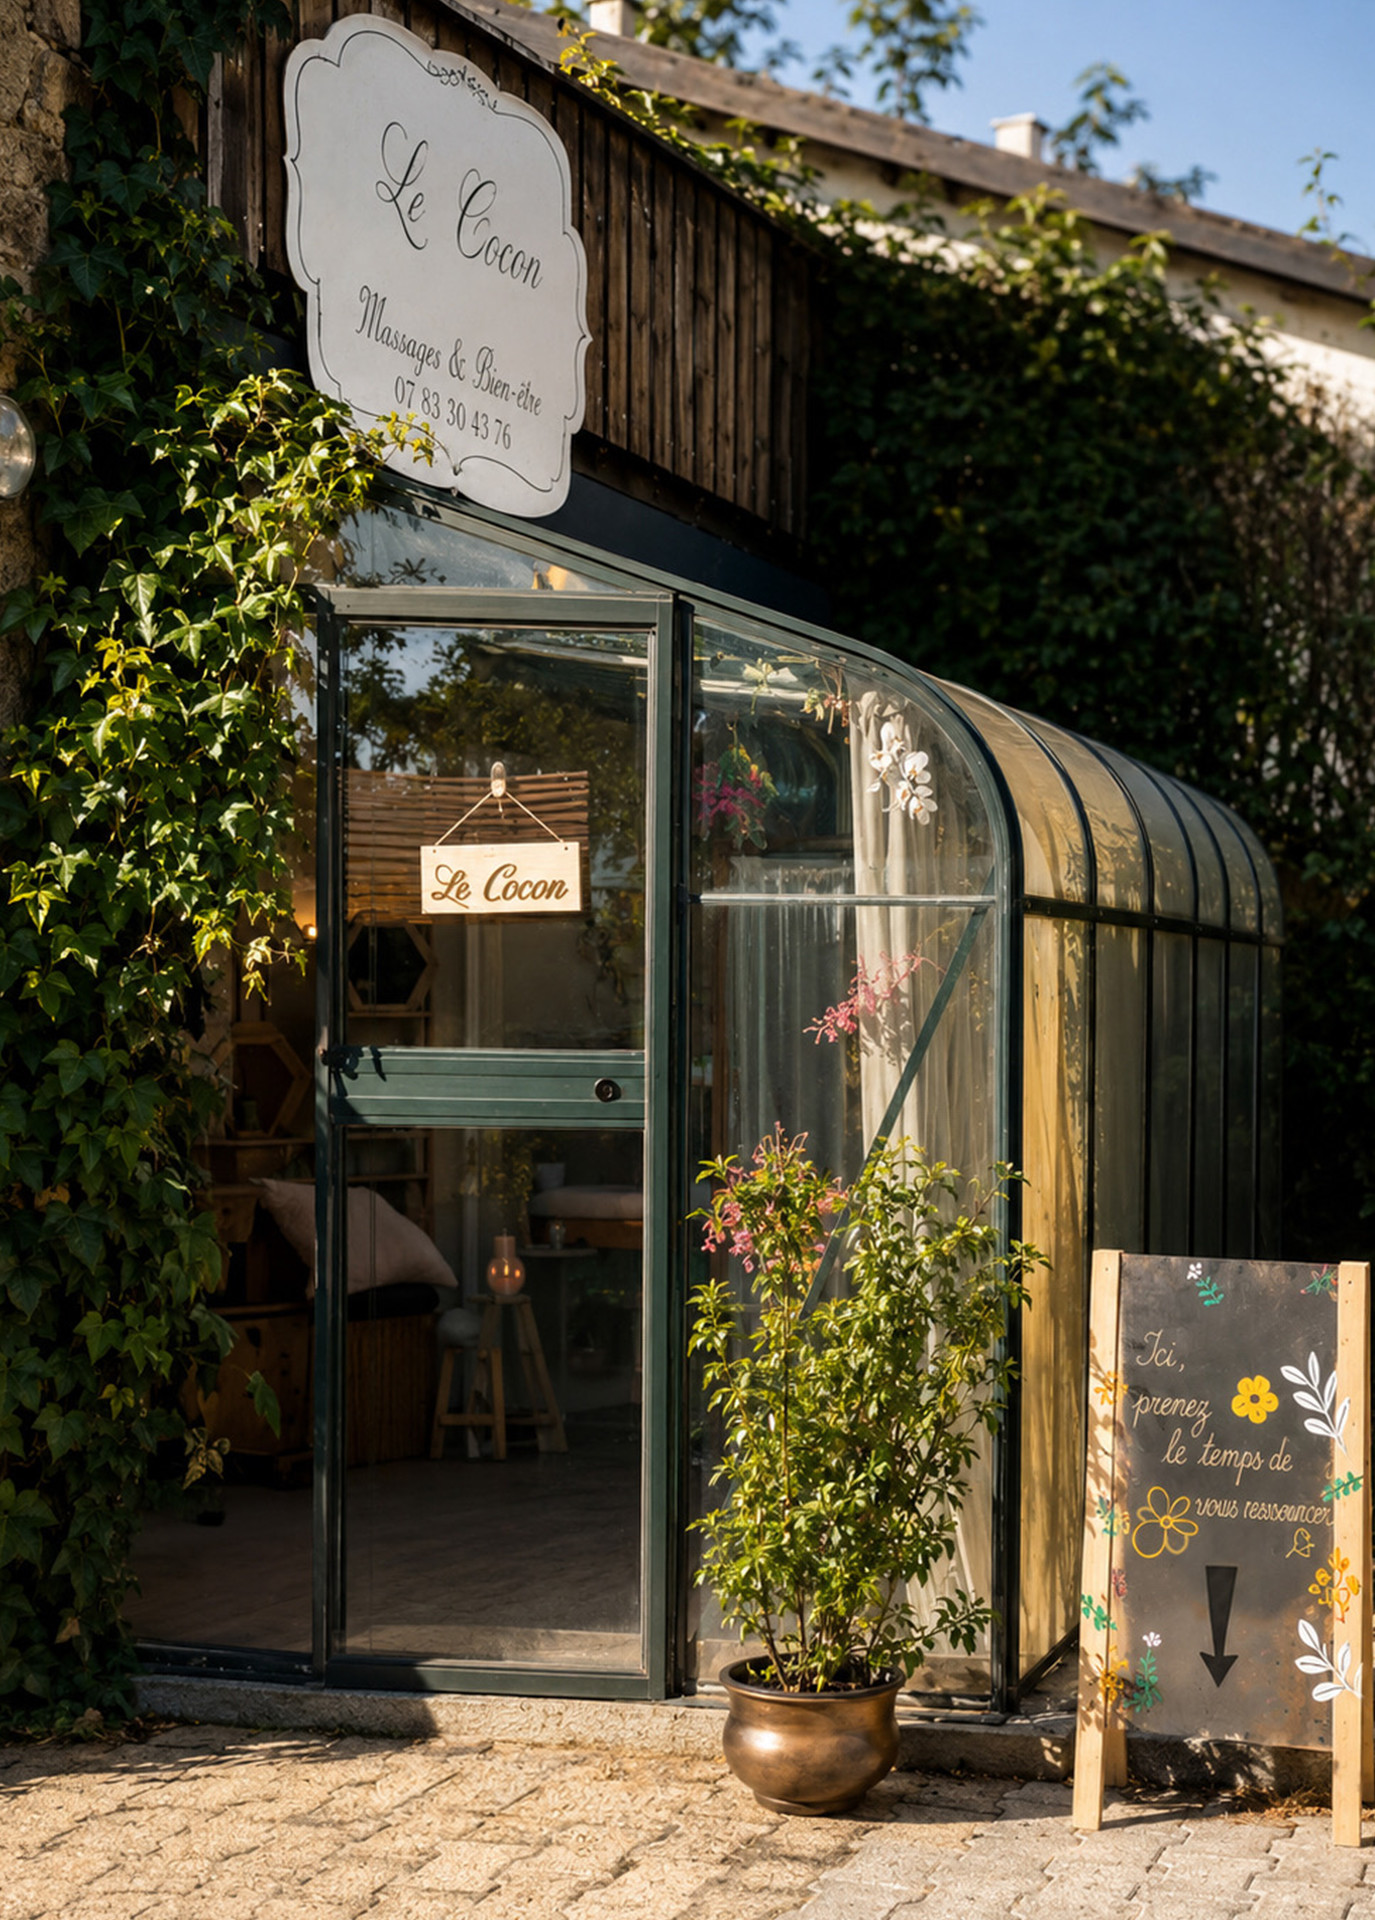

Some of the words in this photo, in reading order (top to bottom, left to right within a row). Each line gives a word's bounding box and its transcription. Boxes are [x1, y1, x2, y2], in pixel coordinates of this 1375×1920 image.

[375, 121, 428, 250] Le
[457, 168, 543, 289] Cocon
[355, 285, 442, 377] Massages
[448, 338, 466, 381] &
[473, 346, 542, 416] Bien-être
[394, 376, 415, 409] 07
[421, 387, 440, 420] 83
[446, 398, 466, 431] 30
[471, 410, 489, 440] 43
[494, 419, 511, 450] 76
[431, 864, 471, 909] Le
[483, 863, 569, 902] Cocon
[1136, 1329, 1185, 1372] Ici,
[1132, 1393, 1212, 1438] prenez
[1161, 1427, 1187, 1465] le
[1197, 1432, 1264, 1486] temps
[1269, 1436, 1293, 1472] de
[1195, 1498, 1239, 1518] vous
